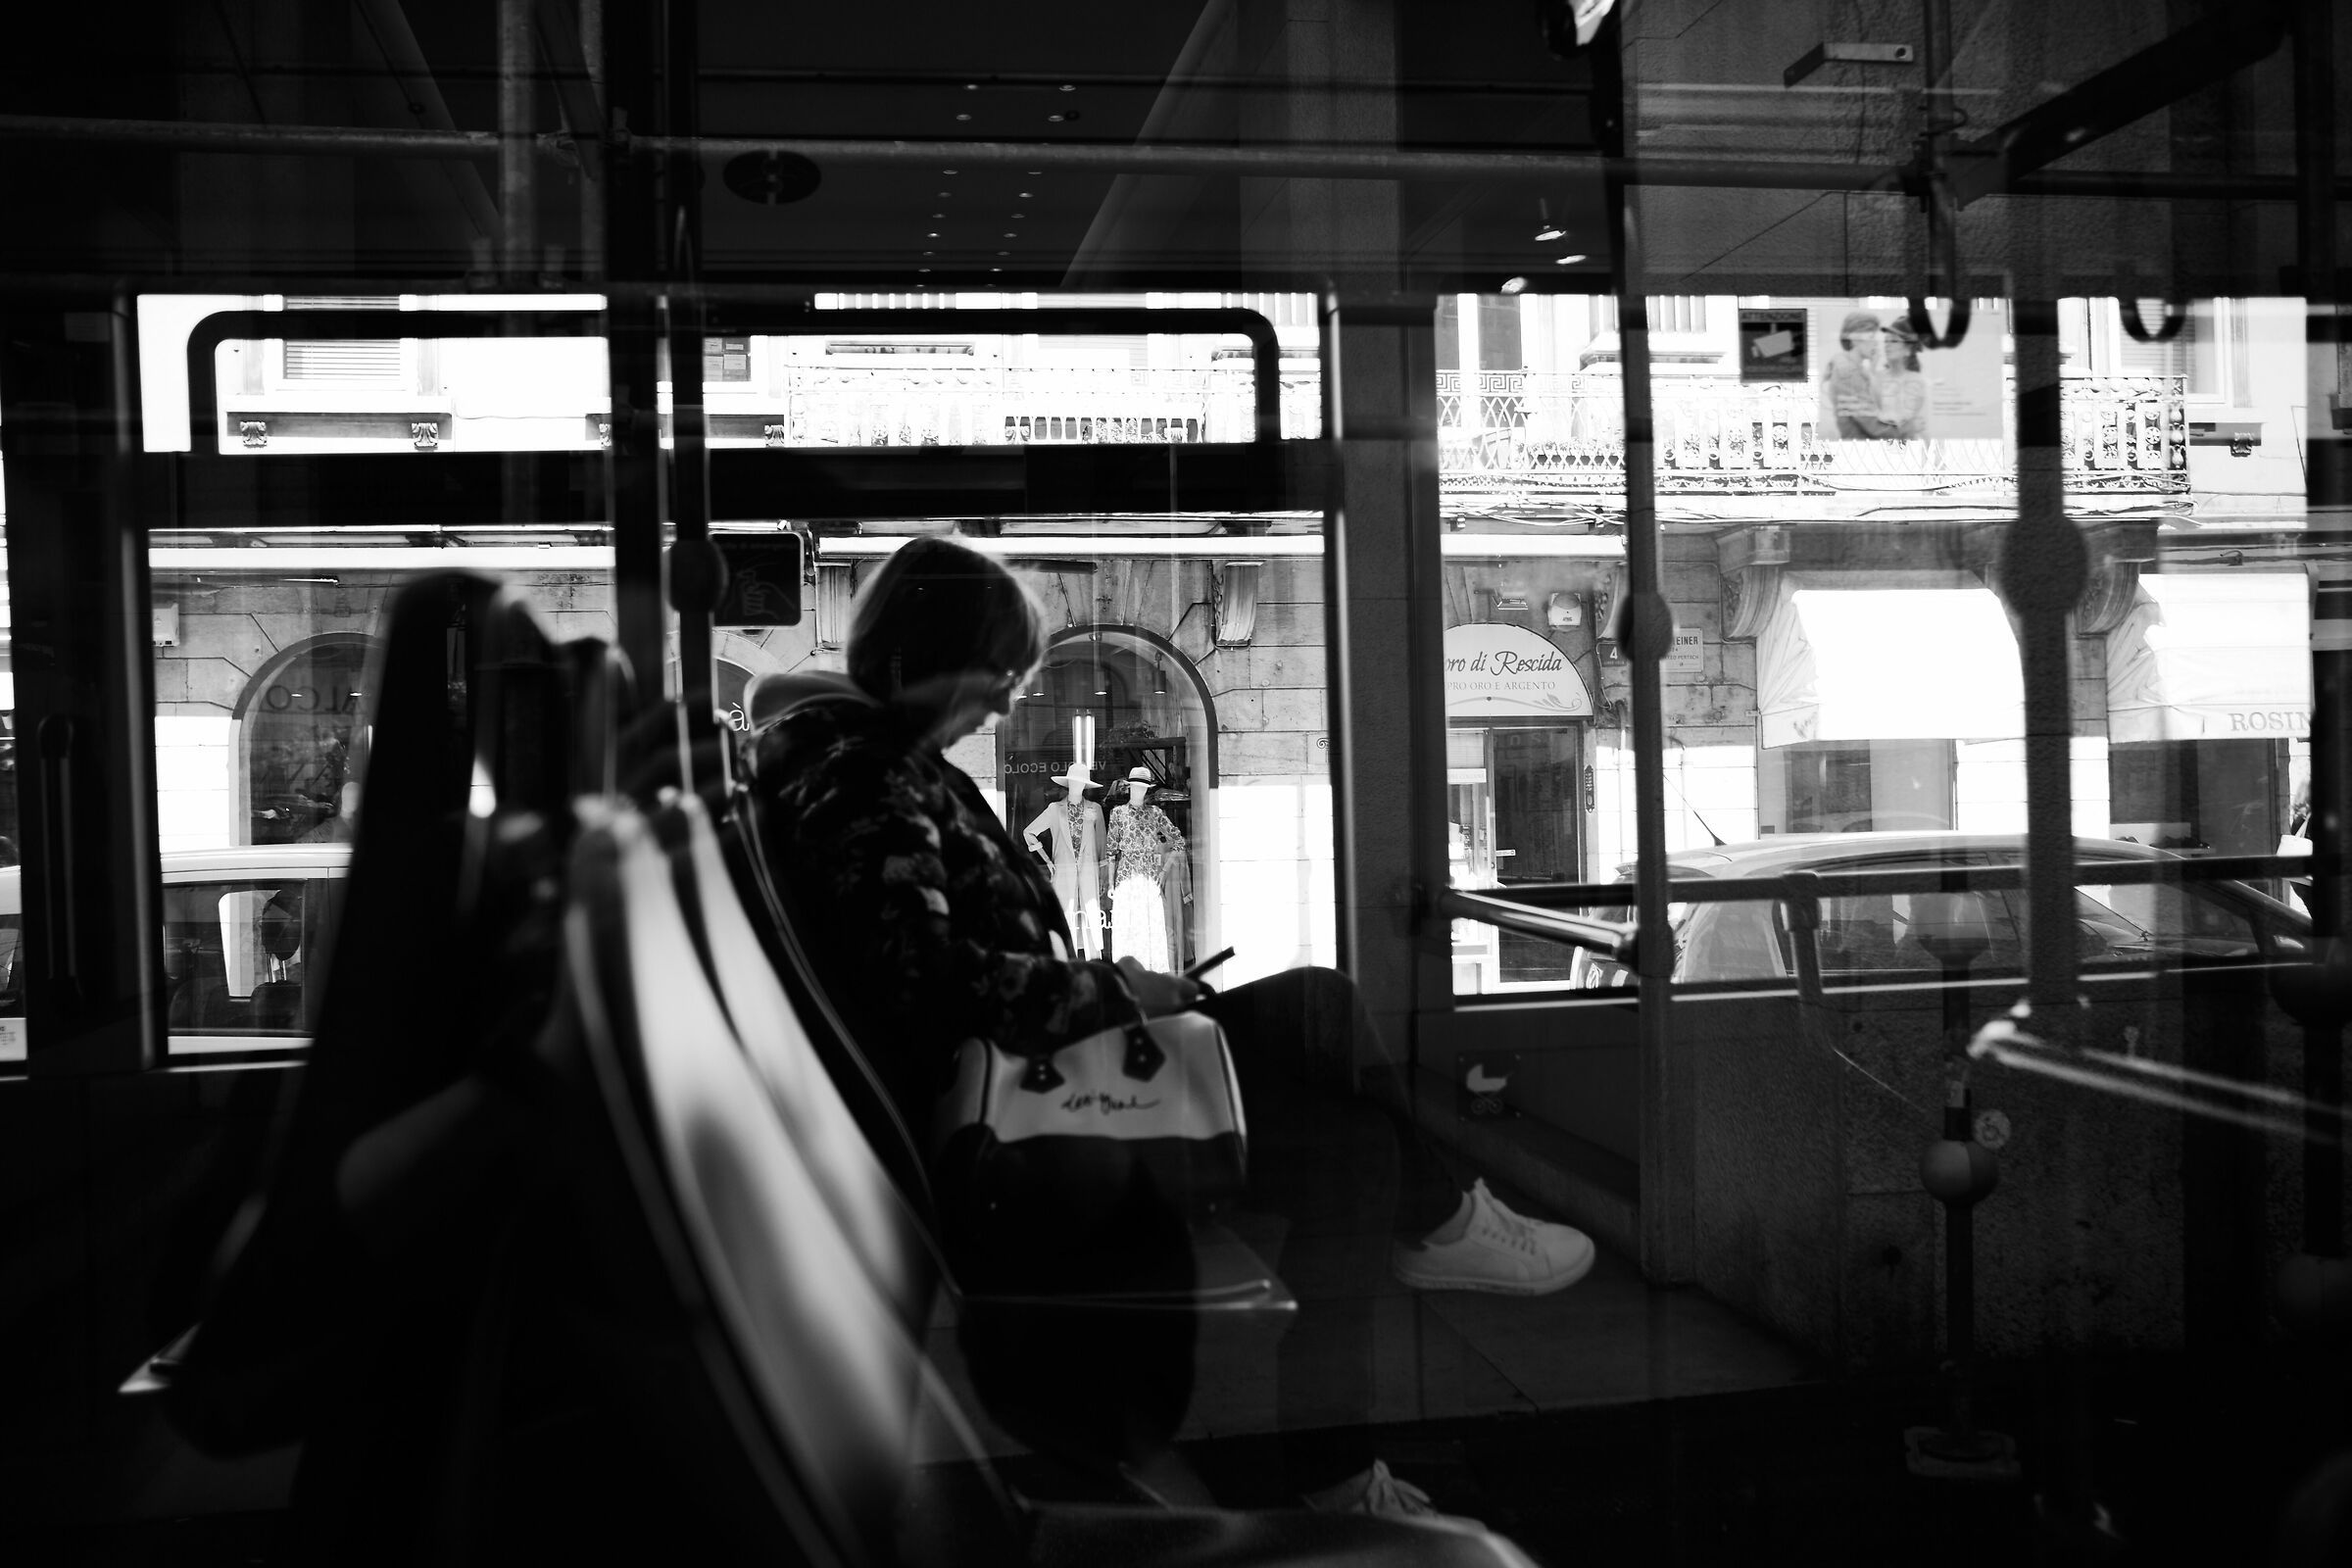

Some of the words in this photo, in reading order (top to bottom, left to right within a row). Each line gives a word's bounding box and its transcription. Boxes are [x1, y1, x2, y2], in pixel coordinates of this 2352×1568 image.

[1609, 646, 1618, 660] 4
[1470, 651, 1488, 672] di
[1490, 651, 1562, 676] Rescida
[1446, 681, 1467, 691] PRO
[1469, 681, 1492, 691] ORO
[1494, 681, 1501, 691] E
[1504, 681, 1556, 691] ARGENTO
